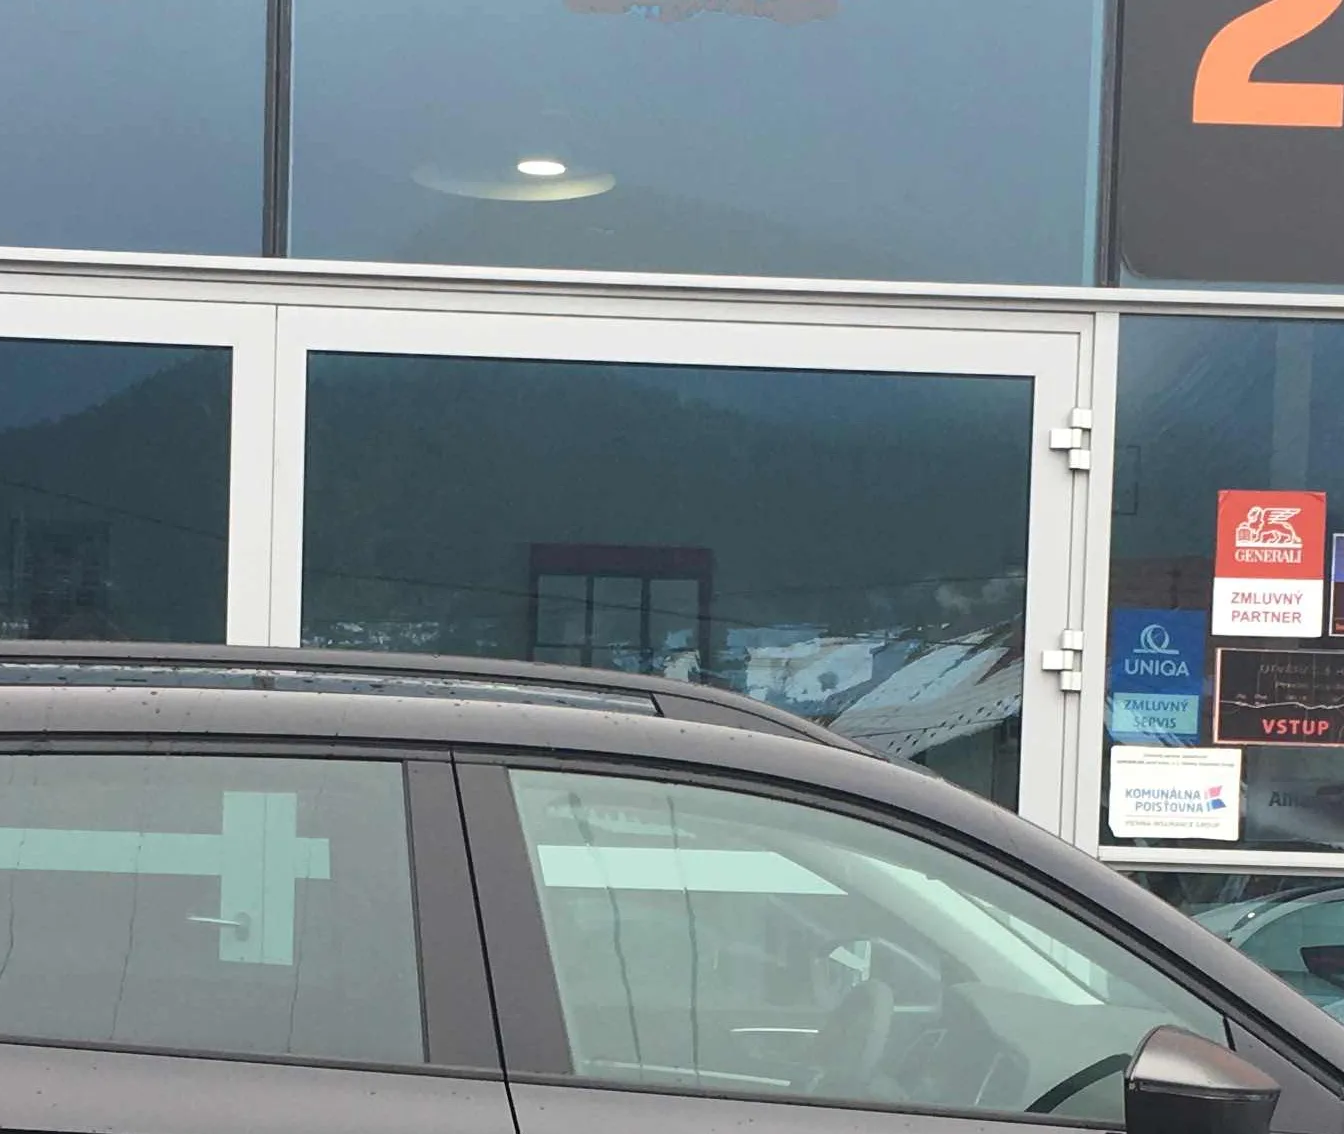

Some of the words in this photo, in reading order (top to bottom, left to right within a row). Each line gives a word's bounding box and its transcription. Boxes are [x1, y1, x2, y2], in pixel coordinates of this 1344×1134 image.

[1235, 549, 1302, 564] GENERALI
[1230, 590, 1303, 605] ZMLUVNÝ
[1231, 610, 1302, 623] PARTNER
[1124, 659, 1190, 676] UNIQA
[1124, 699, 1189, 712] ZMLUVNÝ
[1134, 716, 1177, 729] SERVIS
[1262, 718, 1330, 736] VSTUP
[1124, 786, 1201, 800] KOMUNÁLNA
